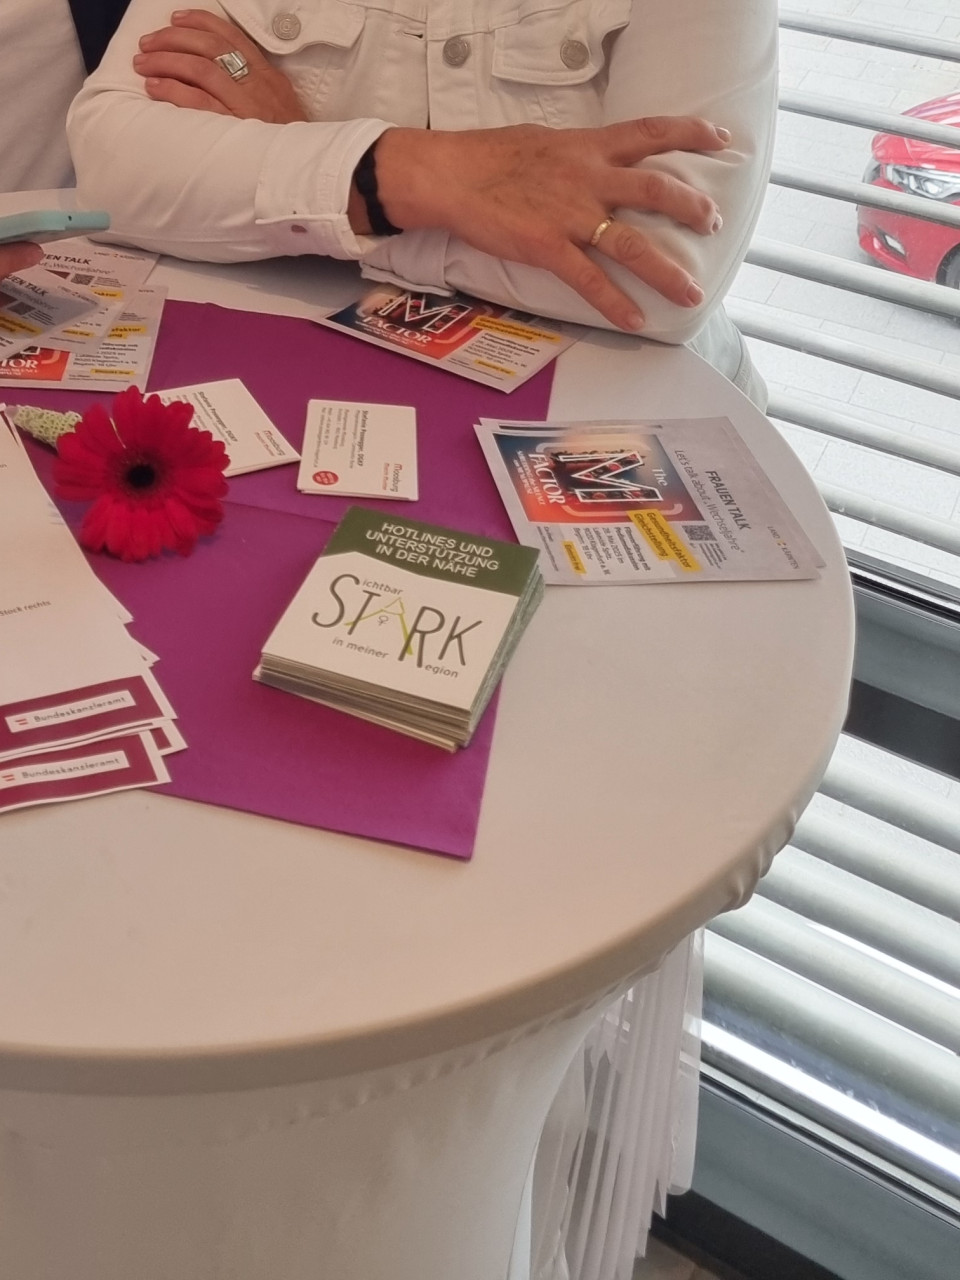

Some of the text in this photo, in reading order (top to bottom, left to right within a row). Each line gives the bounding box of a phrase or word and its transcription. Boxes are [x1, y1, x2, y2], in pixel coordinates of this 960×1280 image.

[527, 453, 567, 504] FACTOR
[650, 468, 671, 486] The
[703, 470, 752, 530] FRAUEN TALK
[365, 530, 500, 571] UNTERSTÜTZUNG
[381, 522, 494, 558] HOTLINES UND
[375, 544, 478, 579] IN DER NÄHE
[312, 573, 483, 669] STARK
[332, 636, 389, 660] in meiner
[32, 695, 128, 724] Bundeskanzleramt
